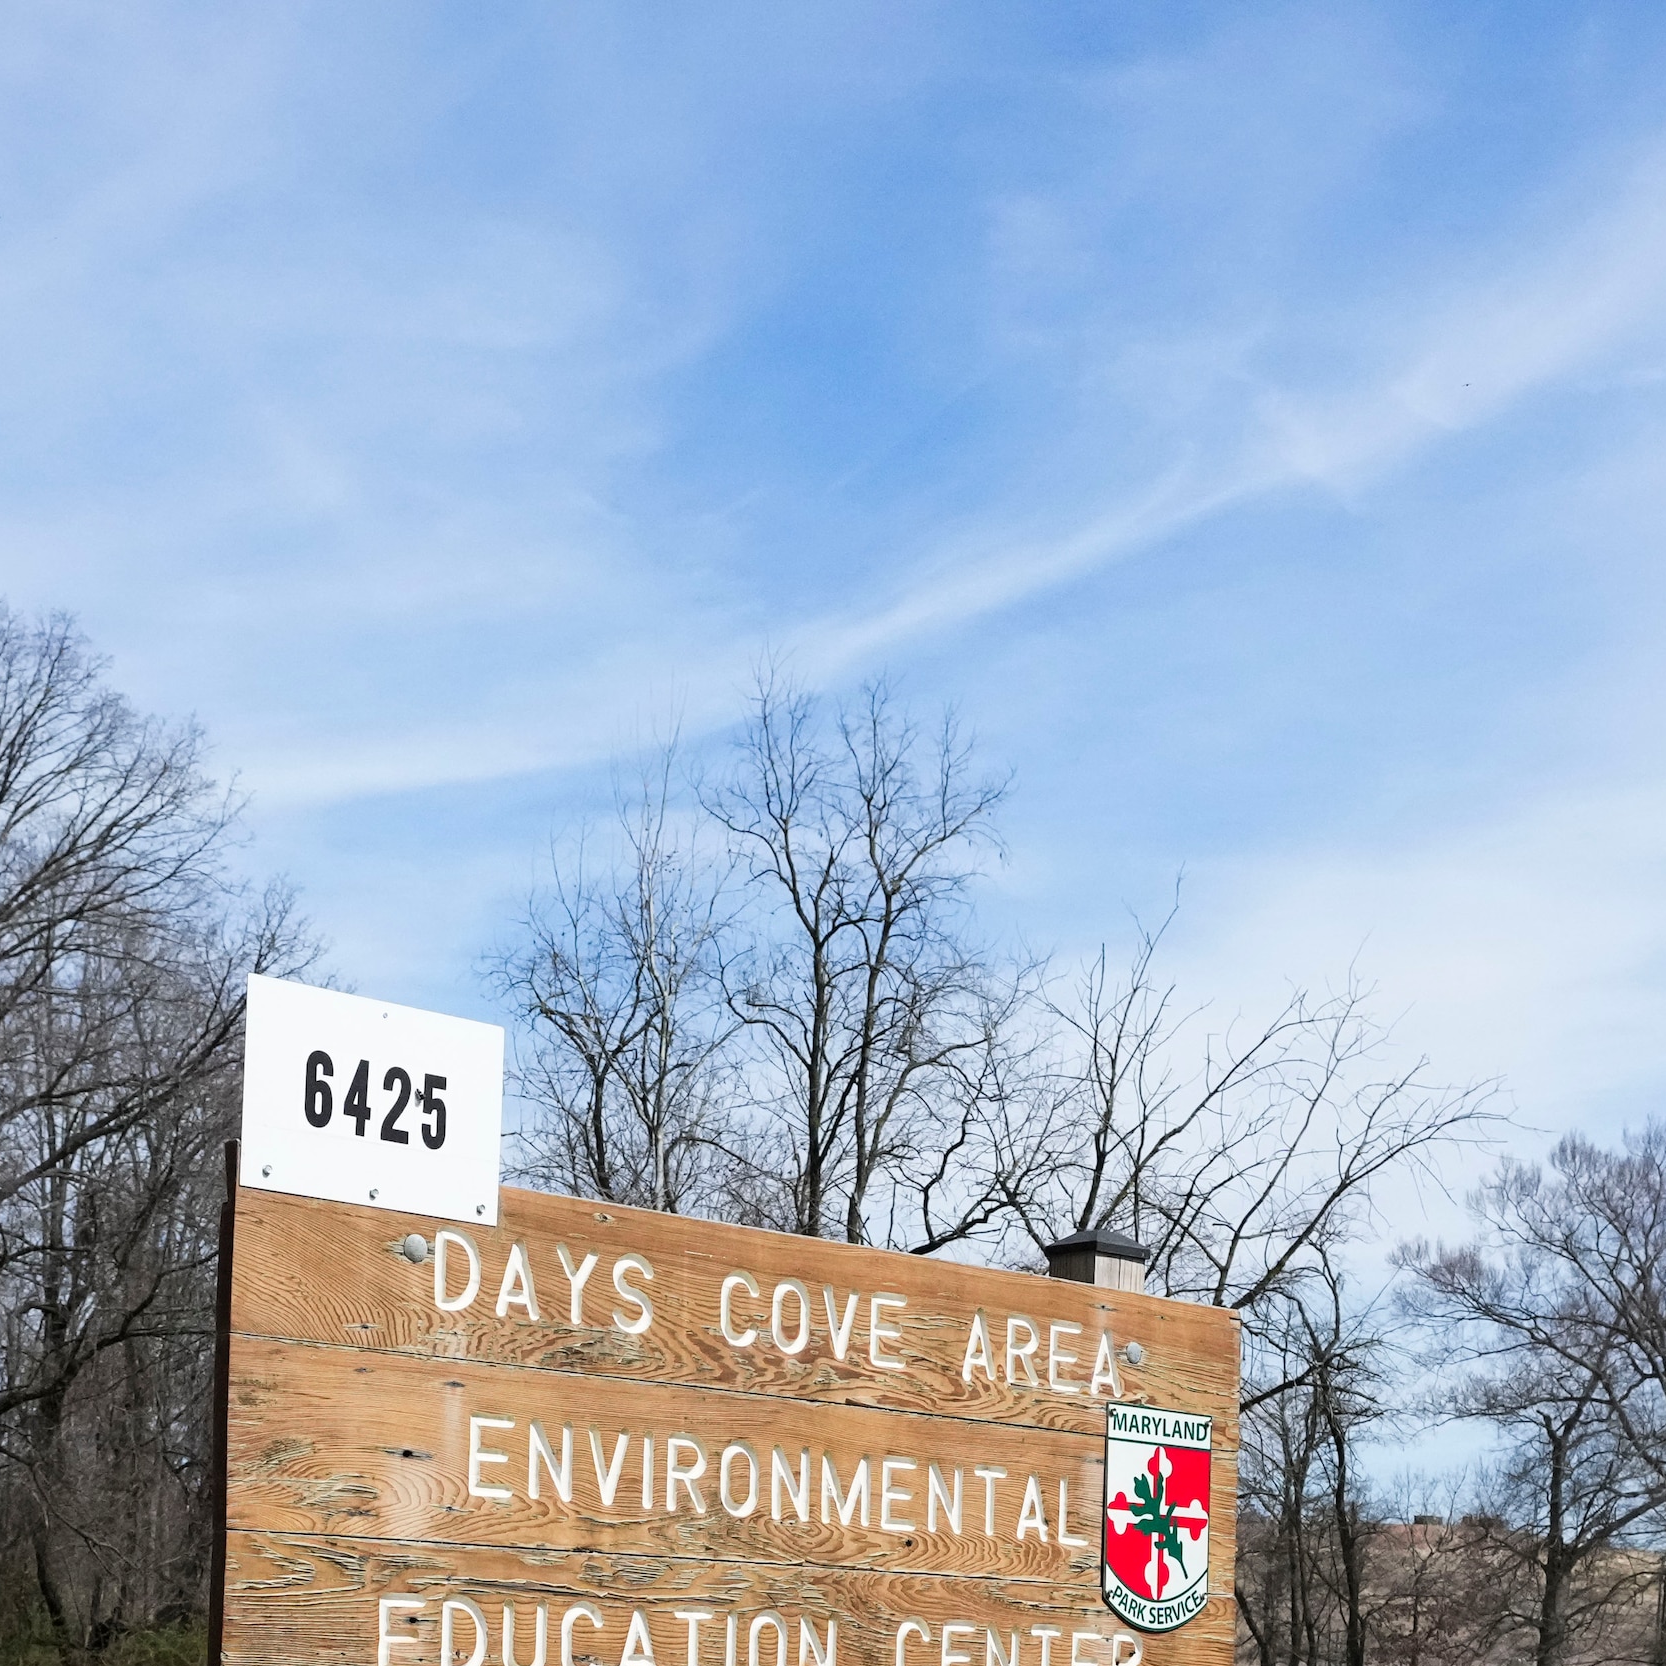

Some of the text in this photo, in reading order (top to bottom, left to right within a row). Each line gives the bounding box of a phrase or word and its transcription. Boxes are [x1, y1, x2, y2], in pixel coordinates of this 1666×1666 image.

[303, 1049, 448, 1151] 6425
[432, 1228, 1126, 1396] DAYS COVE AREA
[1112, 1413, 1208, 1443] MARYLAND
[467, 1414, 1090, 1548] ENVIRONMENTAL
[1111, 1584, 1202, 1625] PARK SERVICE
